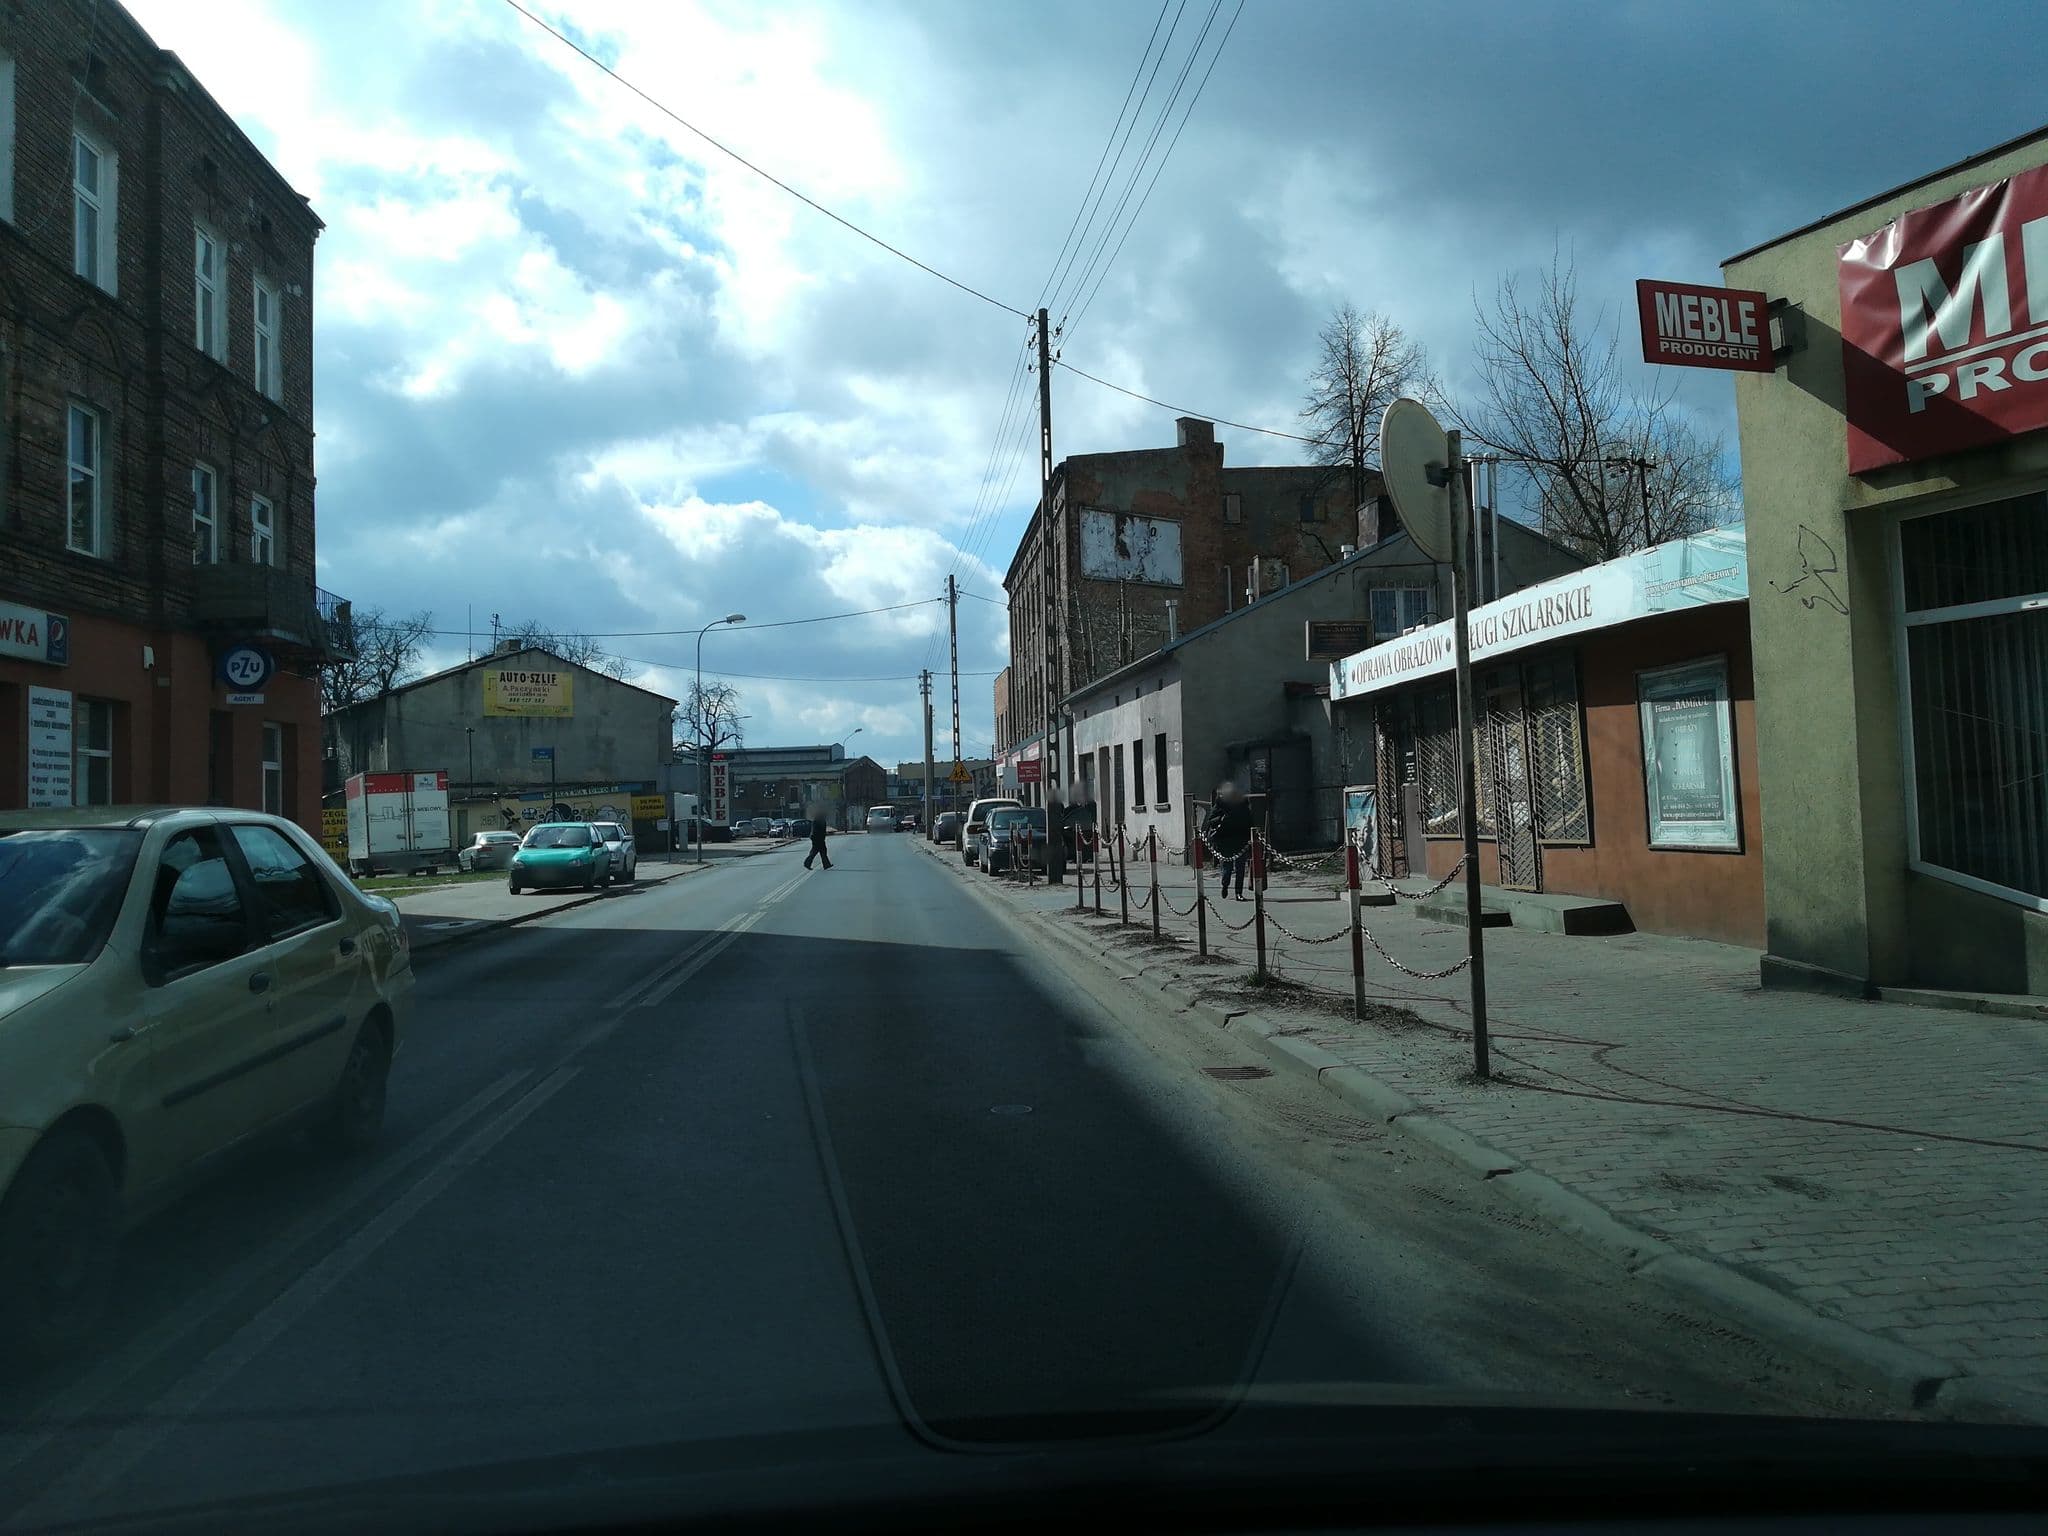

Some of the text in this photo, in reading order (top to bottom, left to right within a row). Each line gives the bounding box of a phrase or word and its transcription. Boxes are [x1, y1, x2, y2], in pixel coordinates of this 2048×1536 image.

[1655, 291, 1759, 346] MEBLE
[1660, 341, 1760, 361] PRODUCENT
[1356, 585, 1593, 685] OPRAWA OBRAZÓW ŁUGI SZKLARSKIE
[232, 656, 260, 678] PZU
[712, 765, 725, 820] MEBLE
